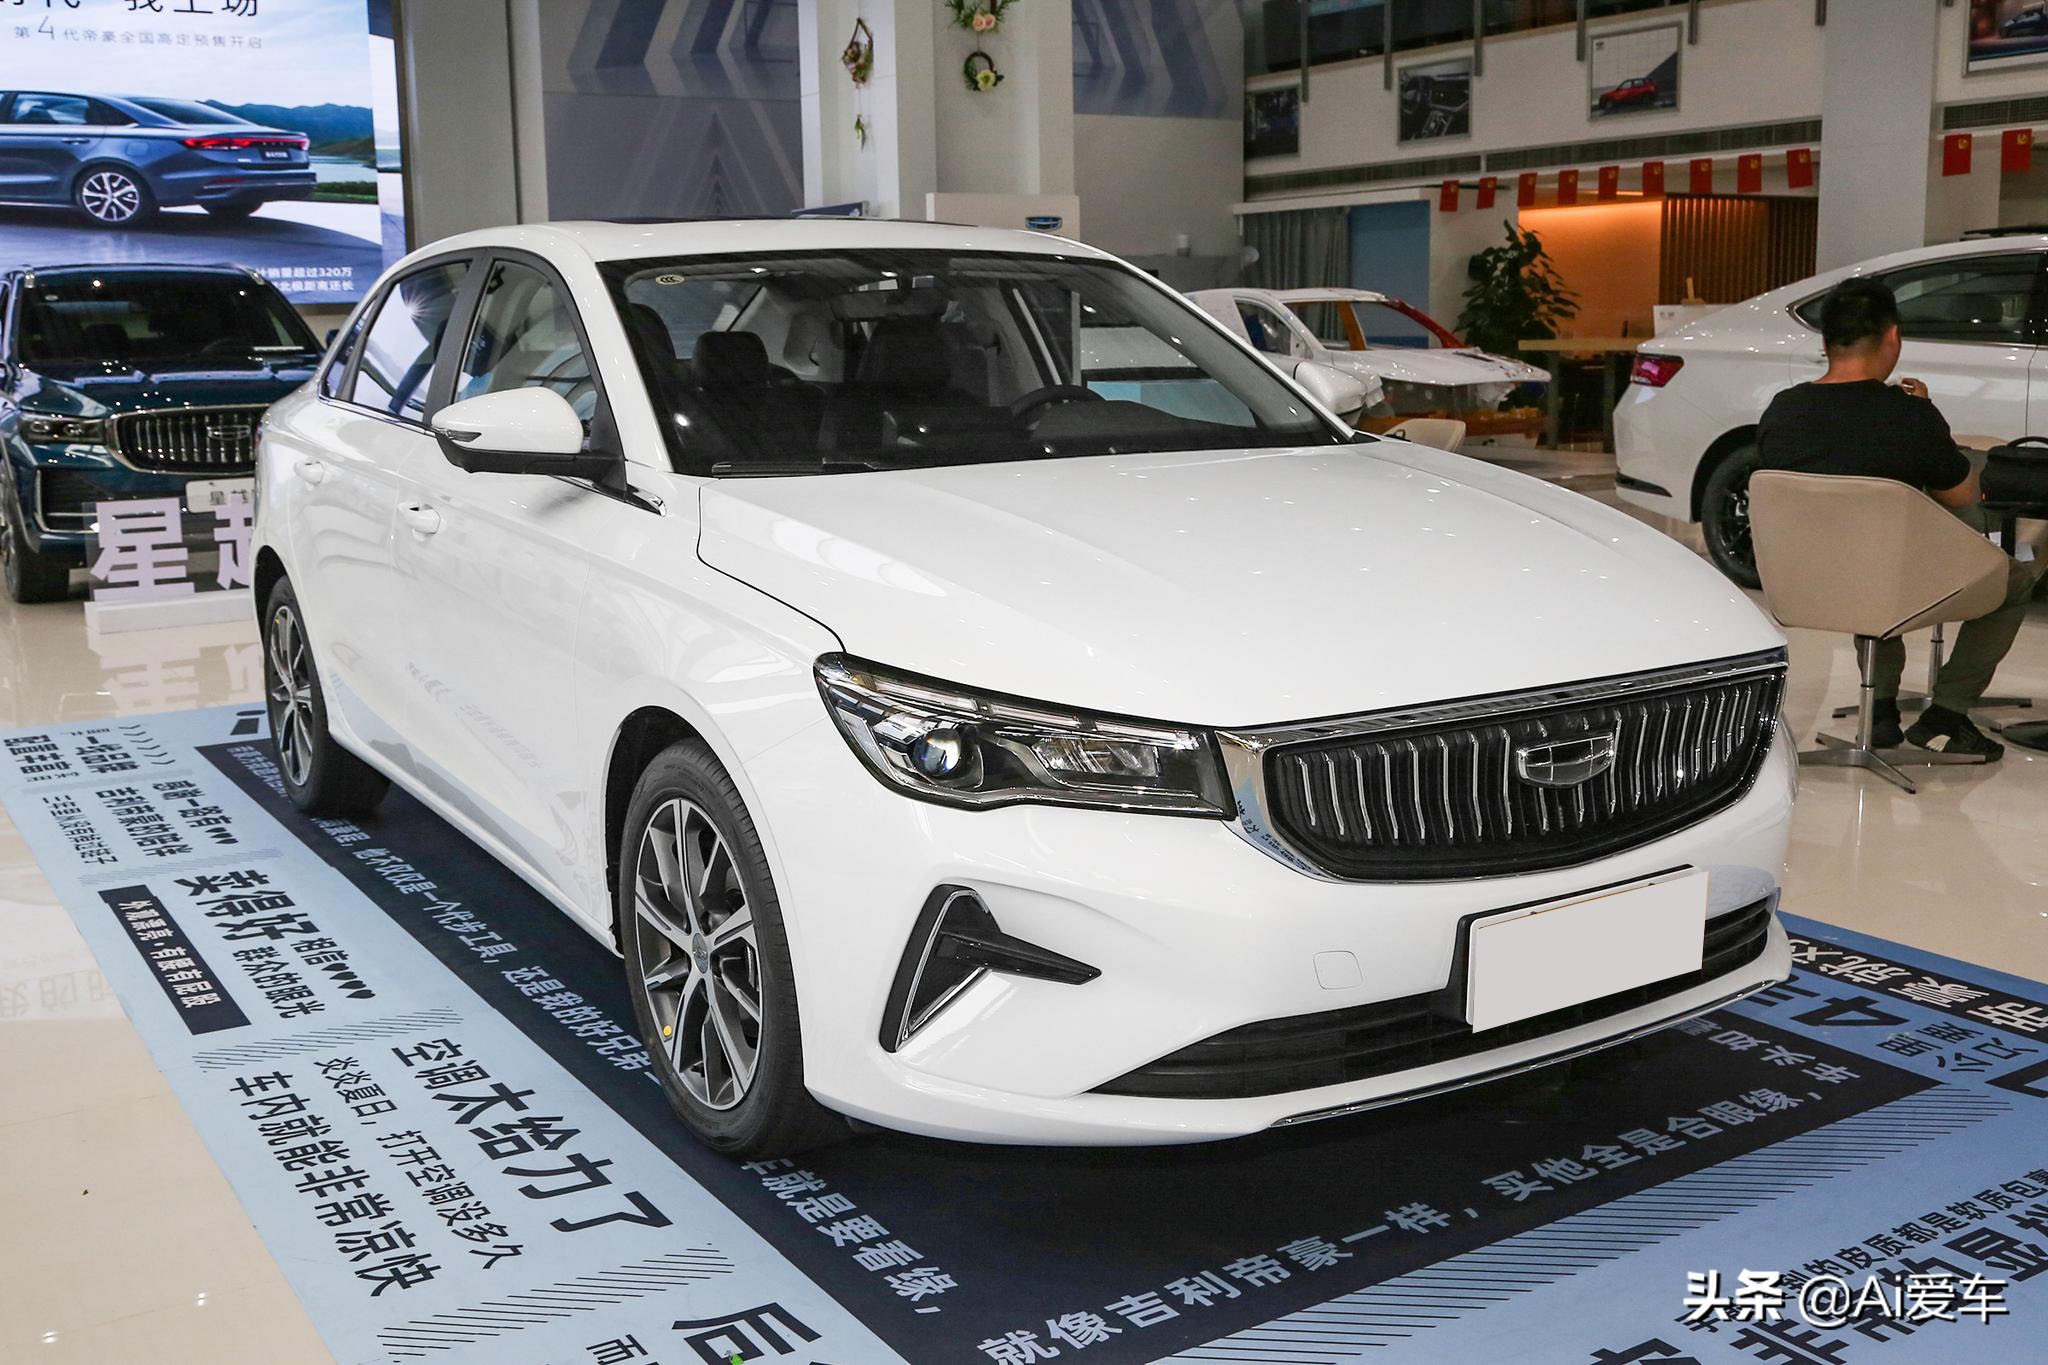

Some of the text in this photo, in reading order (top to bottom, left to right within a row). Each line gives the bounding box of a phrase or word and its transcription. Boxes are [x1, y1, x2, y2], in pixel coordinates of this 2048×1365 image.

[95, 786, 194, 857] 吉利帝豪的陪伴
[174, 869, 351, 965] 卖得好 相信
[232, 946, 326, 1019] 群众的眼光
[1875, 1032, 1994, 1073] 公里
[1916, 1020, 2040, 1060] 只要
[391, 1037, 675, 1233] 空调太给力了
[229, 1070, 442, 1297] 车内就能非常凉快
